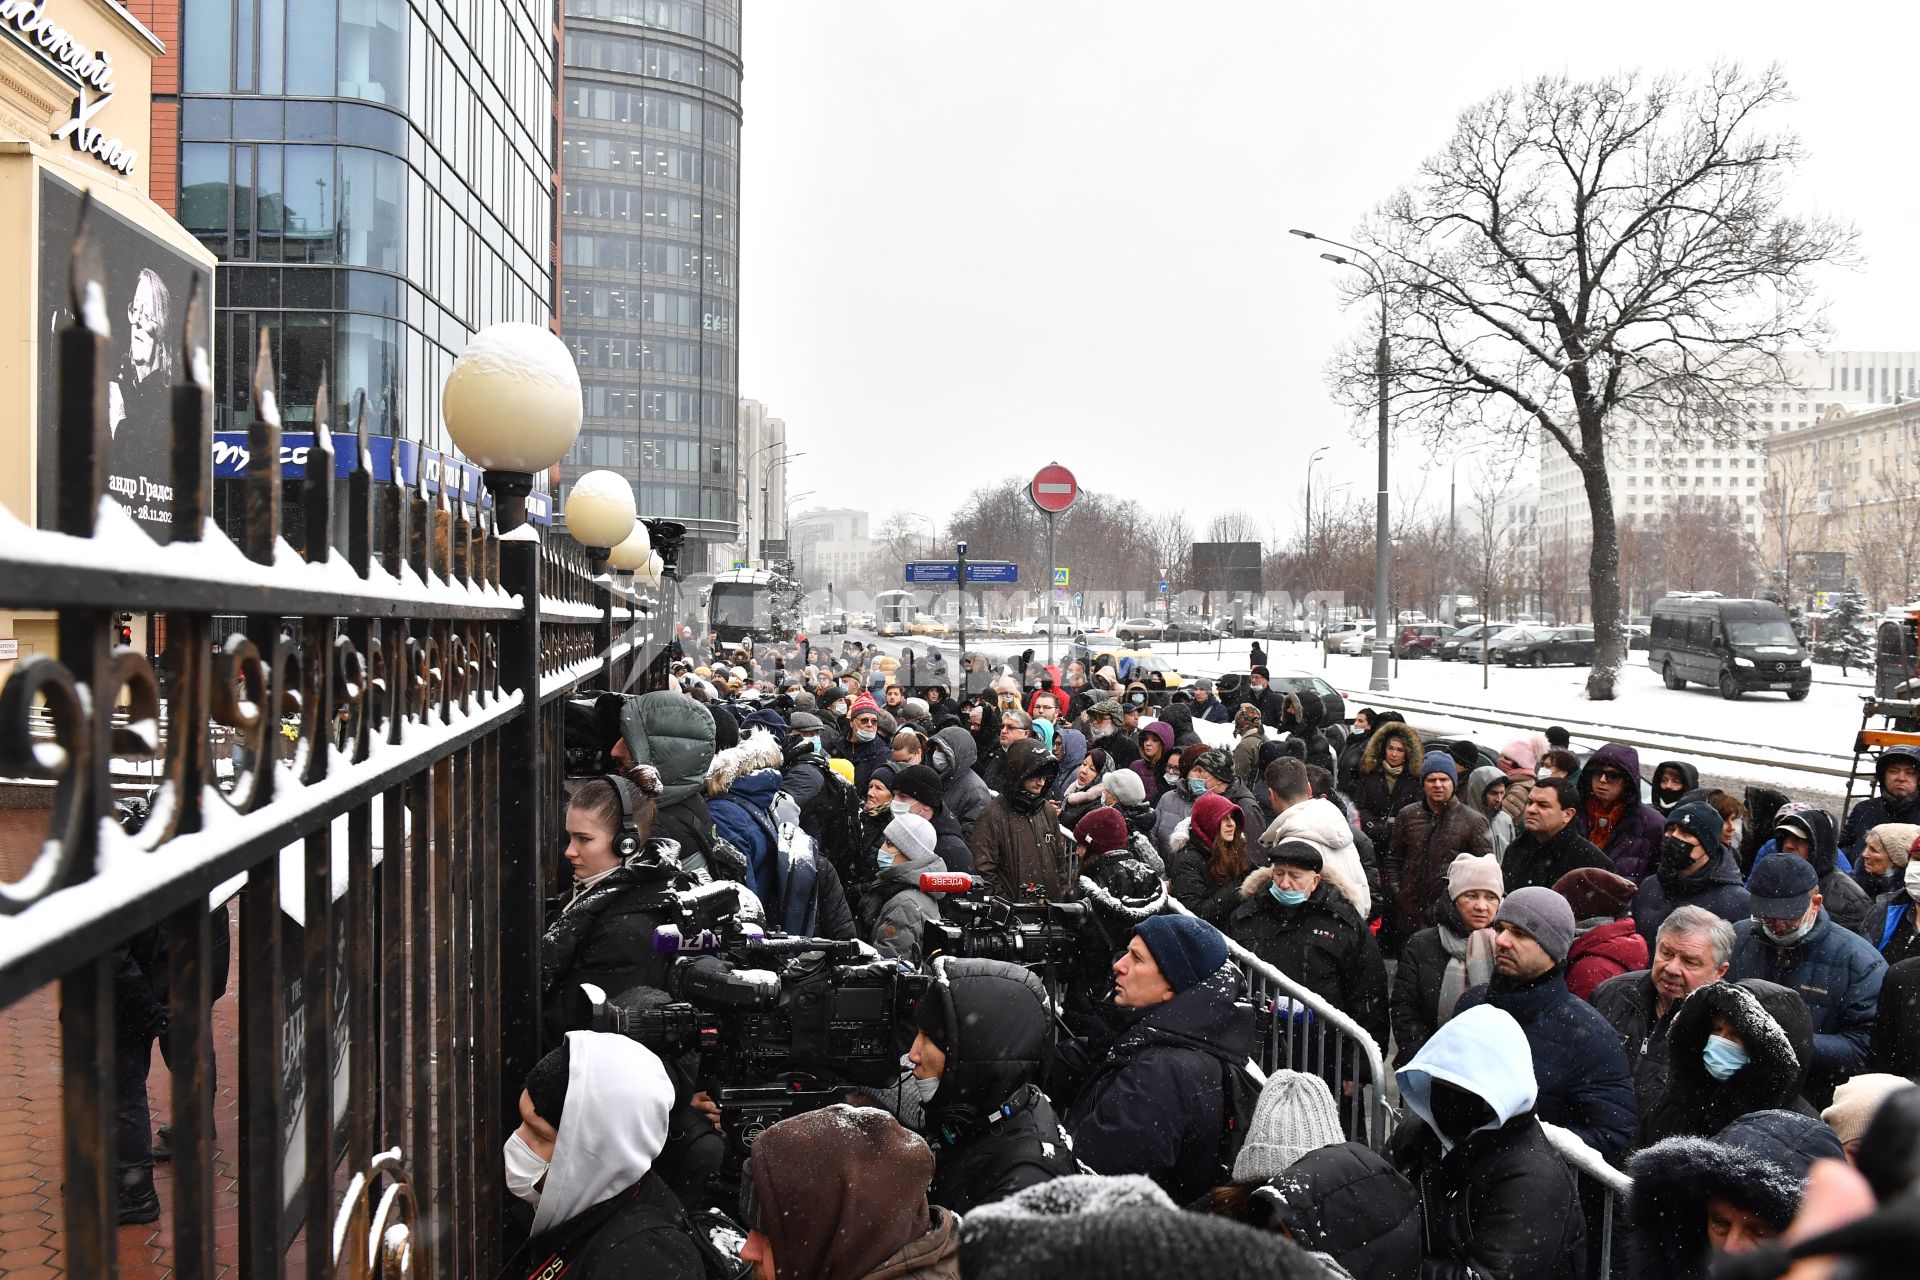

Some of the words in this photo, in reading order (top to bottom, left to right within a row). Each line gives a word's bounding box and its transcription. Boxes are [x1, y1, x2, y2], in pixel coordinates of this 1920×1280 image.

[52, 65, 138, 175] Холл
[109, 475, 137, 499] андр
[139, 475, 173, 502] Градс
[138, 504, 173, 523] 28.11.202
[931, 878, 963, 887] ЗВЕЗДА
